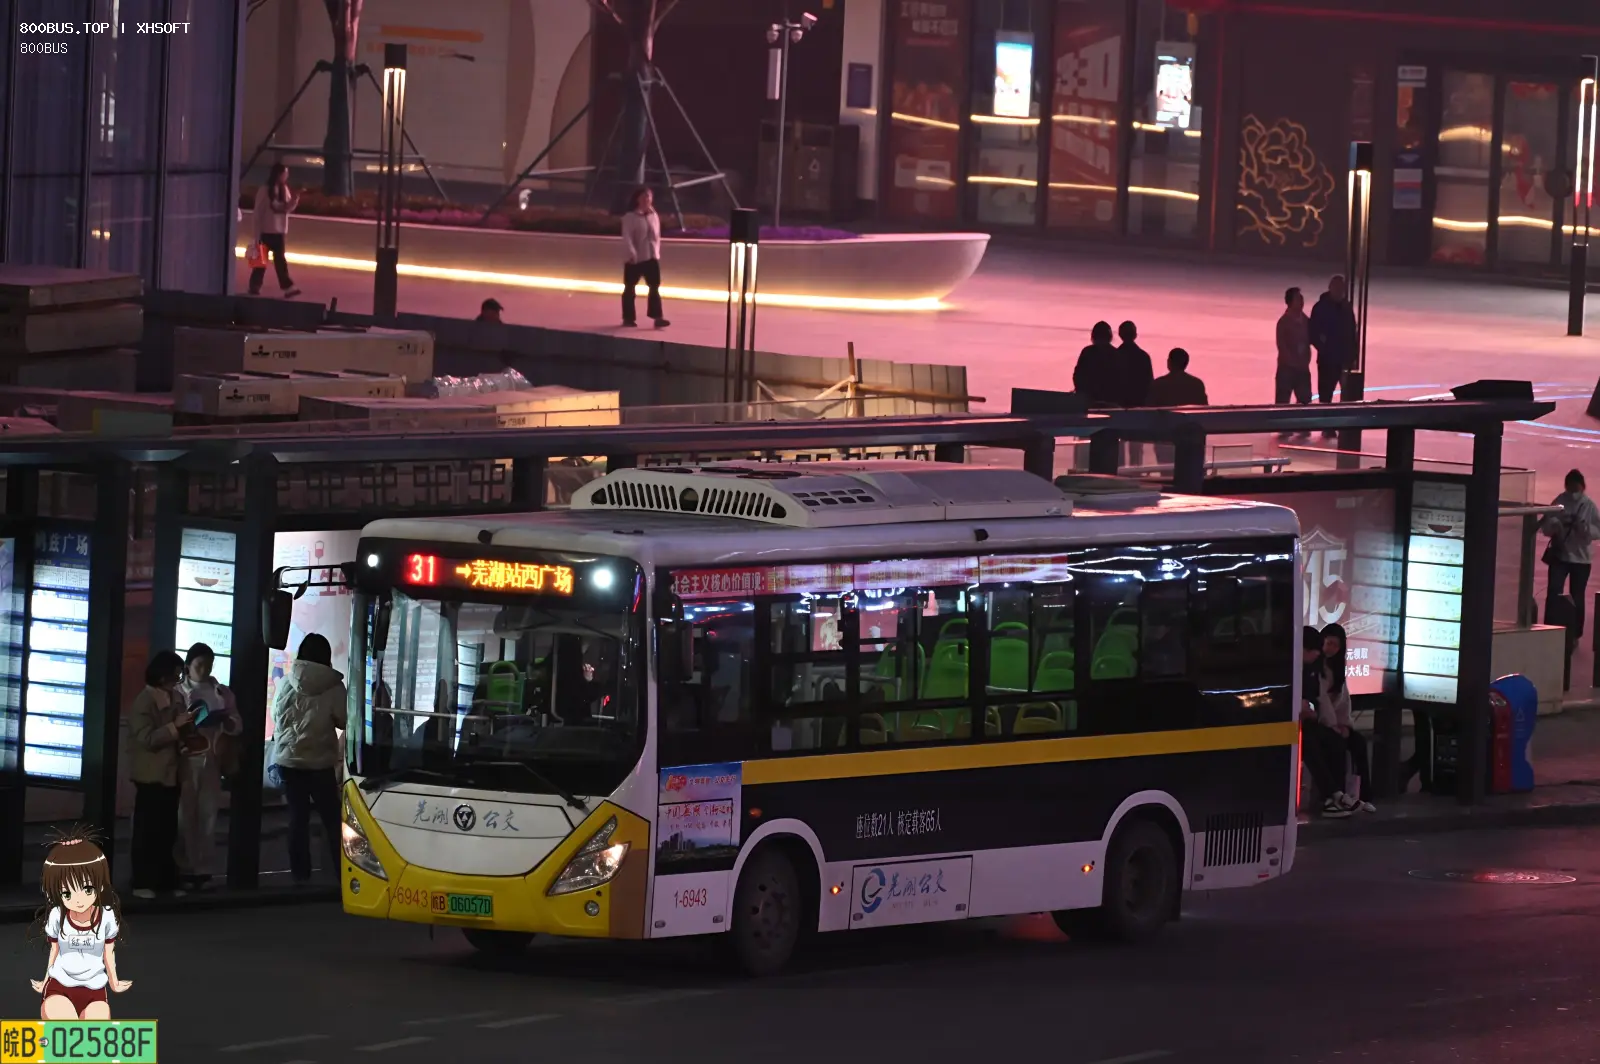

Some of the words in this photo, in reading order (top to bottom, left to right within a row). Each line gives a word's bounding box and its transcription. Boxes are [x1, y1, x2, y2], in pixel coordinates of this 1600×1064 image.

[411, 553, 435, 583] 31
[471, 558, 574, 594] 芜湖站西广场
[855, 811, 894, 839] 座位数21人
[896, 807, 943, 837] 核定载客65人
[673, 888, 707, 909] 1-6943
